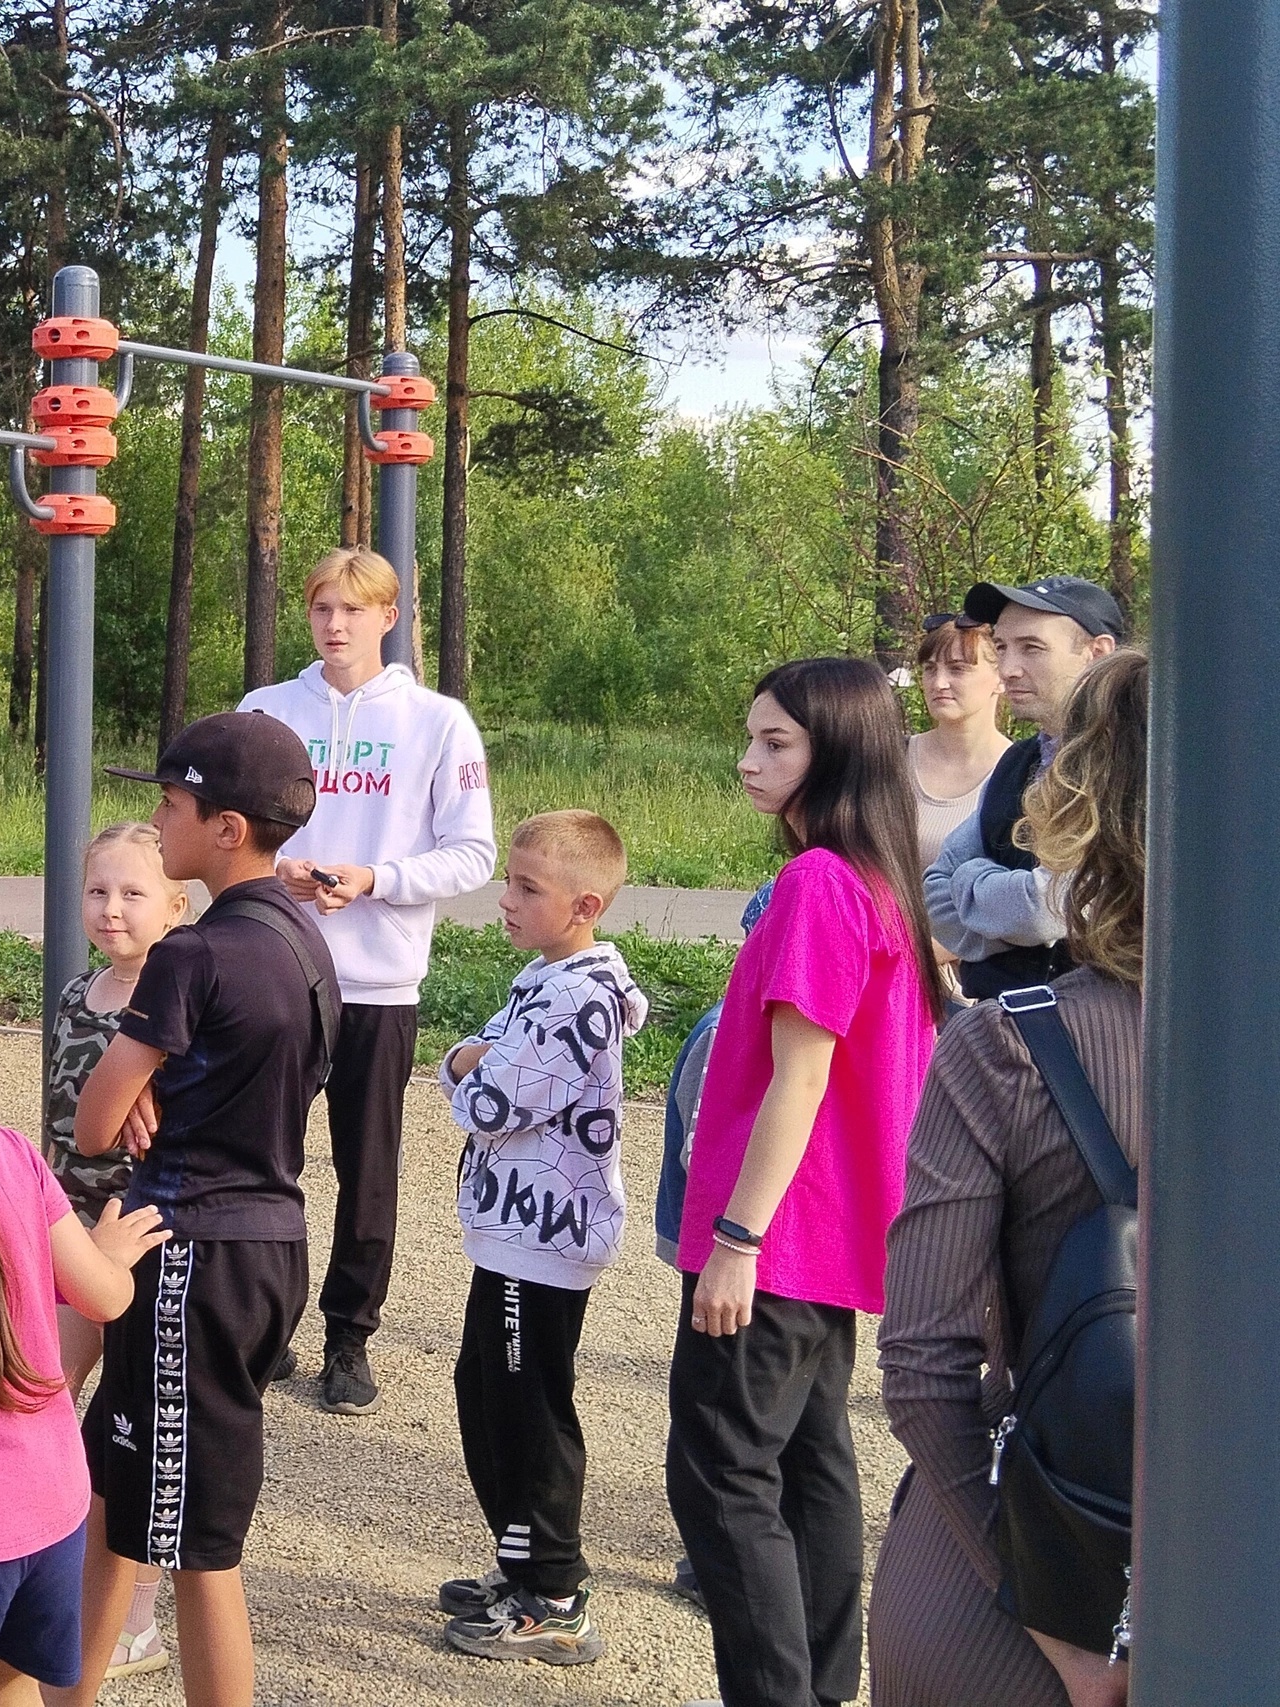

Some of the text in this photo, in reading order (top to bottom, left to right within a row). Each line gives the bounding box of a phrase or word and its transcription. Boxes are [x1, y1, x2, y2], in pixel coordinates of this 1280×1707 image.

[308, 739, 396, 768] ПОРТ
[313, 769, 392, 796] ДОМ
[459, 761, 485, 791] RES
[504, 1275, 520, 1331] HITE
